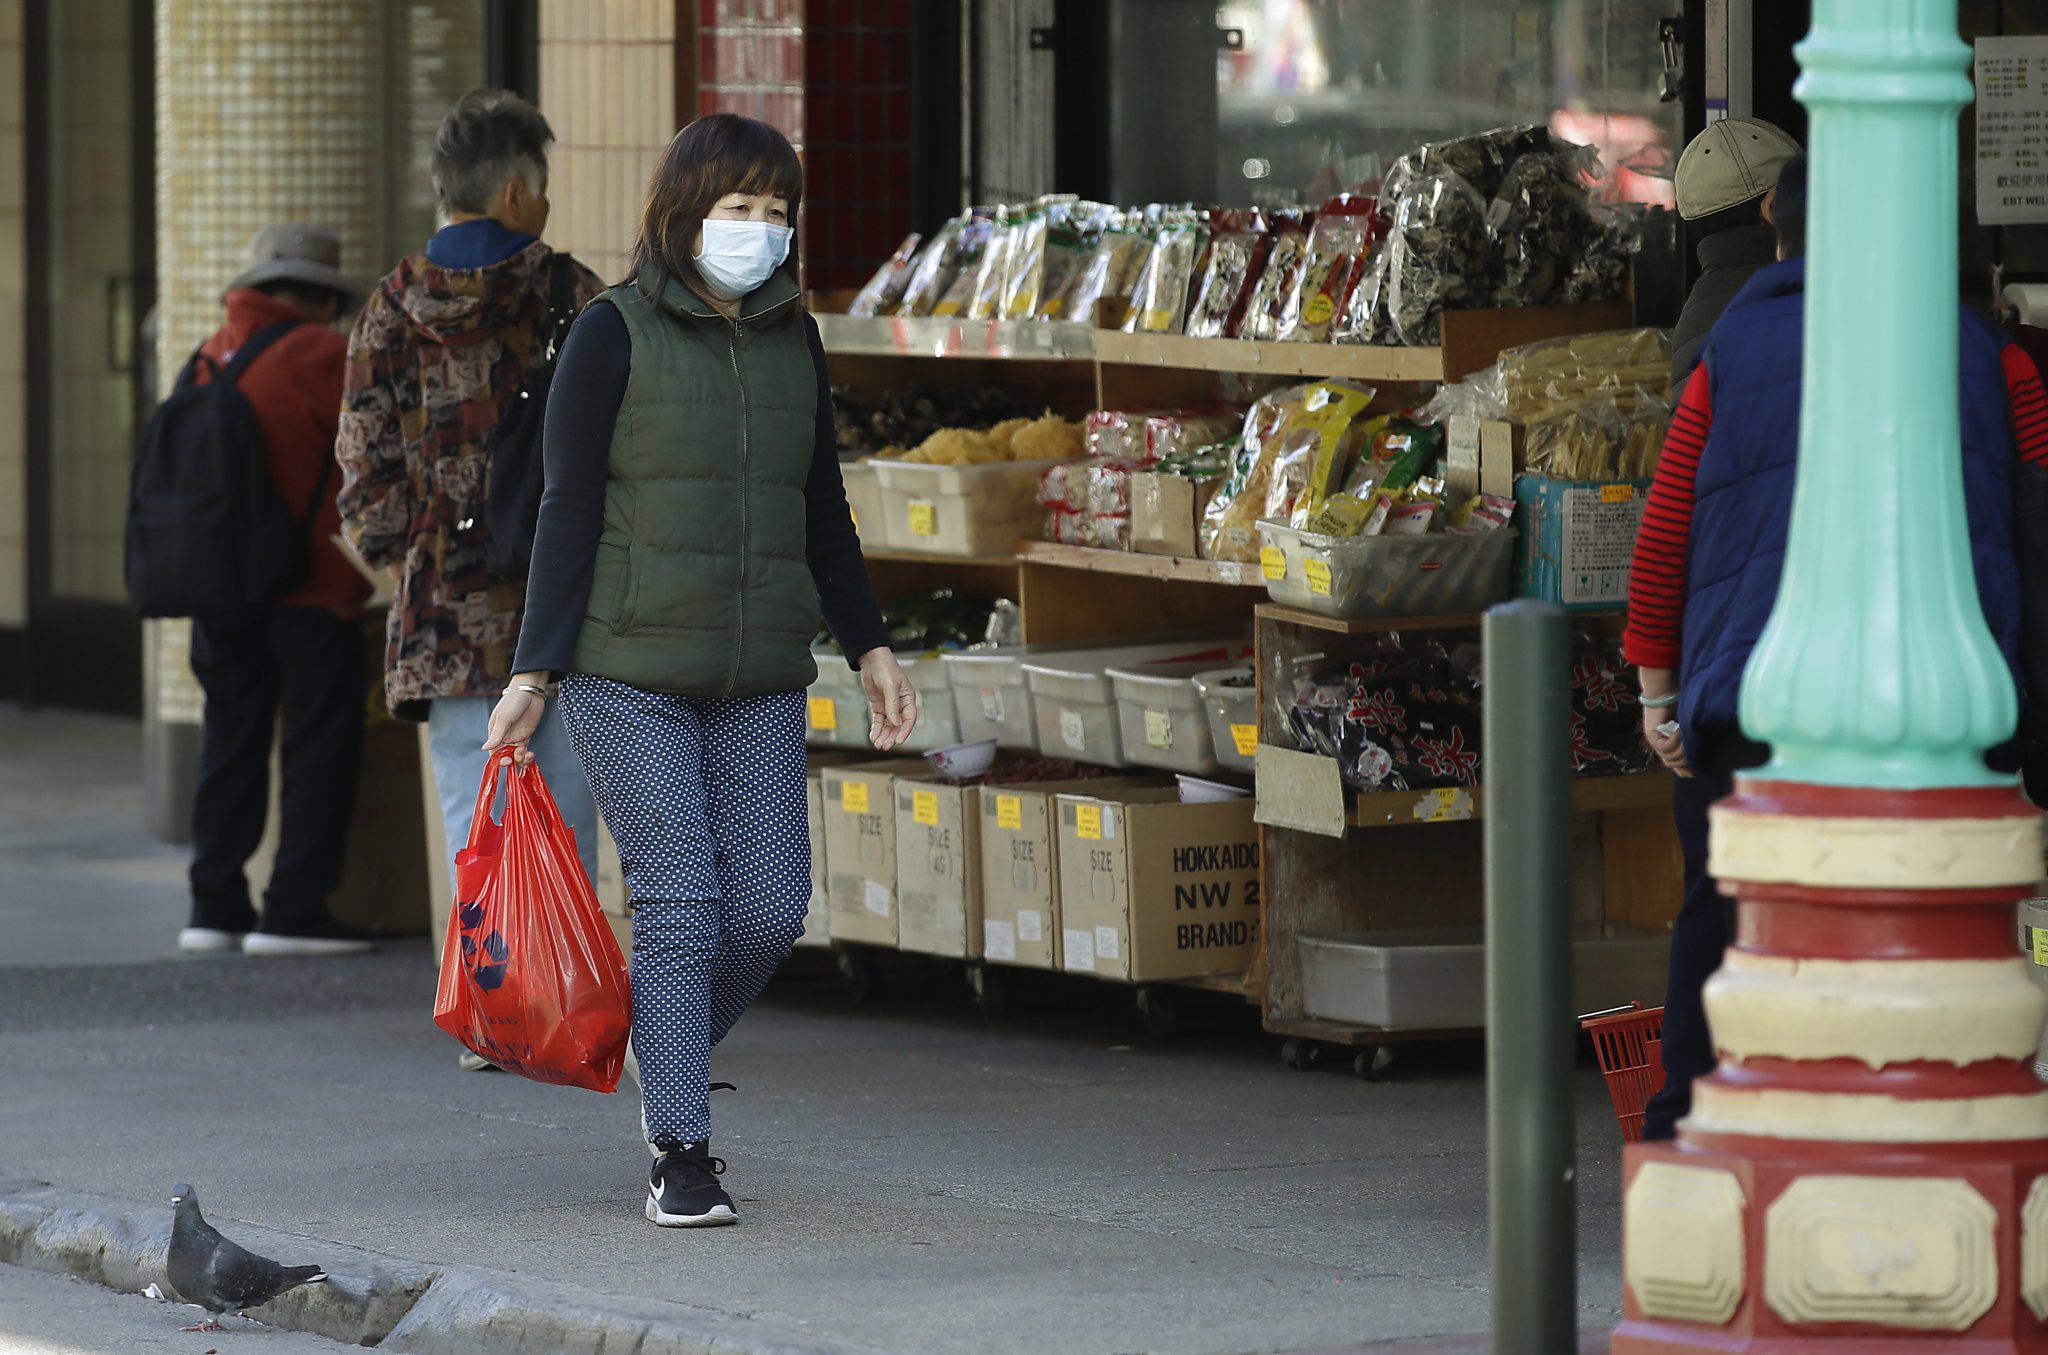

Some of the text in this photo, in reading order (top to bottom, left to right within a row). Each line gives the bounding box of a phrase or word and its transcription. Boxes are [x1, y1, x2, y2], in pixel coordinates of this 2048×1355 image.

[2003, 195, 2048, 206] EBT WEL
[858, 813, 883, 836] SIZE
[928, 826, 950, 849] SIZE
[1012, 839, 1035, 861] SIZE
[1090, 849, 1113, 872] SIZE
[1173, 842, 1260, 873] HOKKAIDO
[1175, 880, 1232, 910] NW
